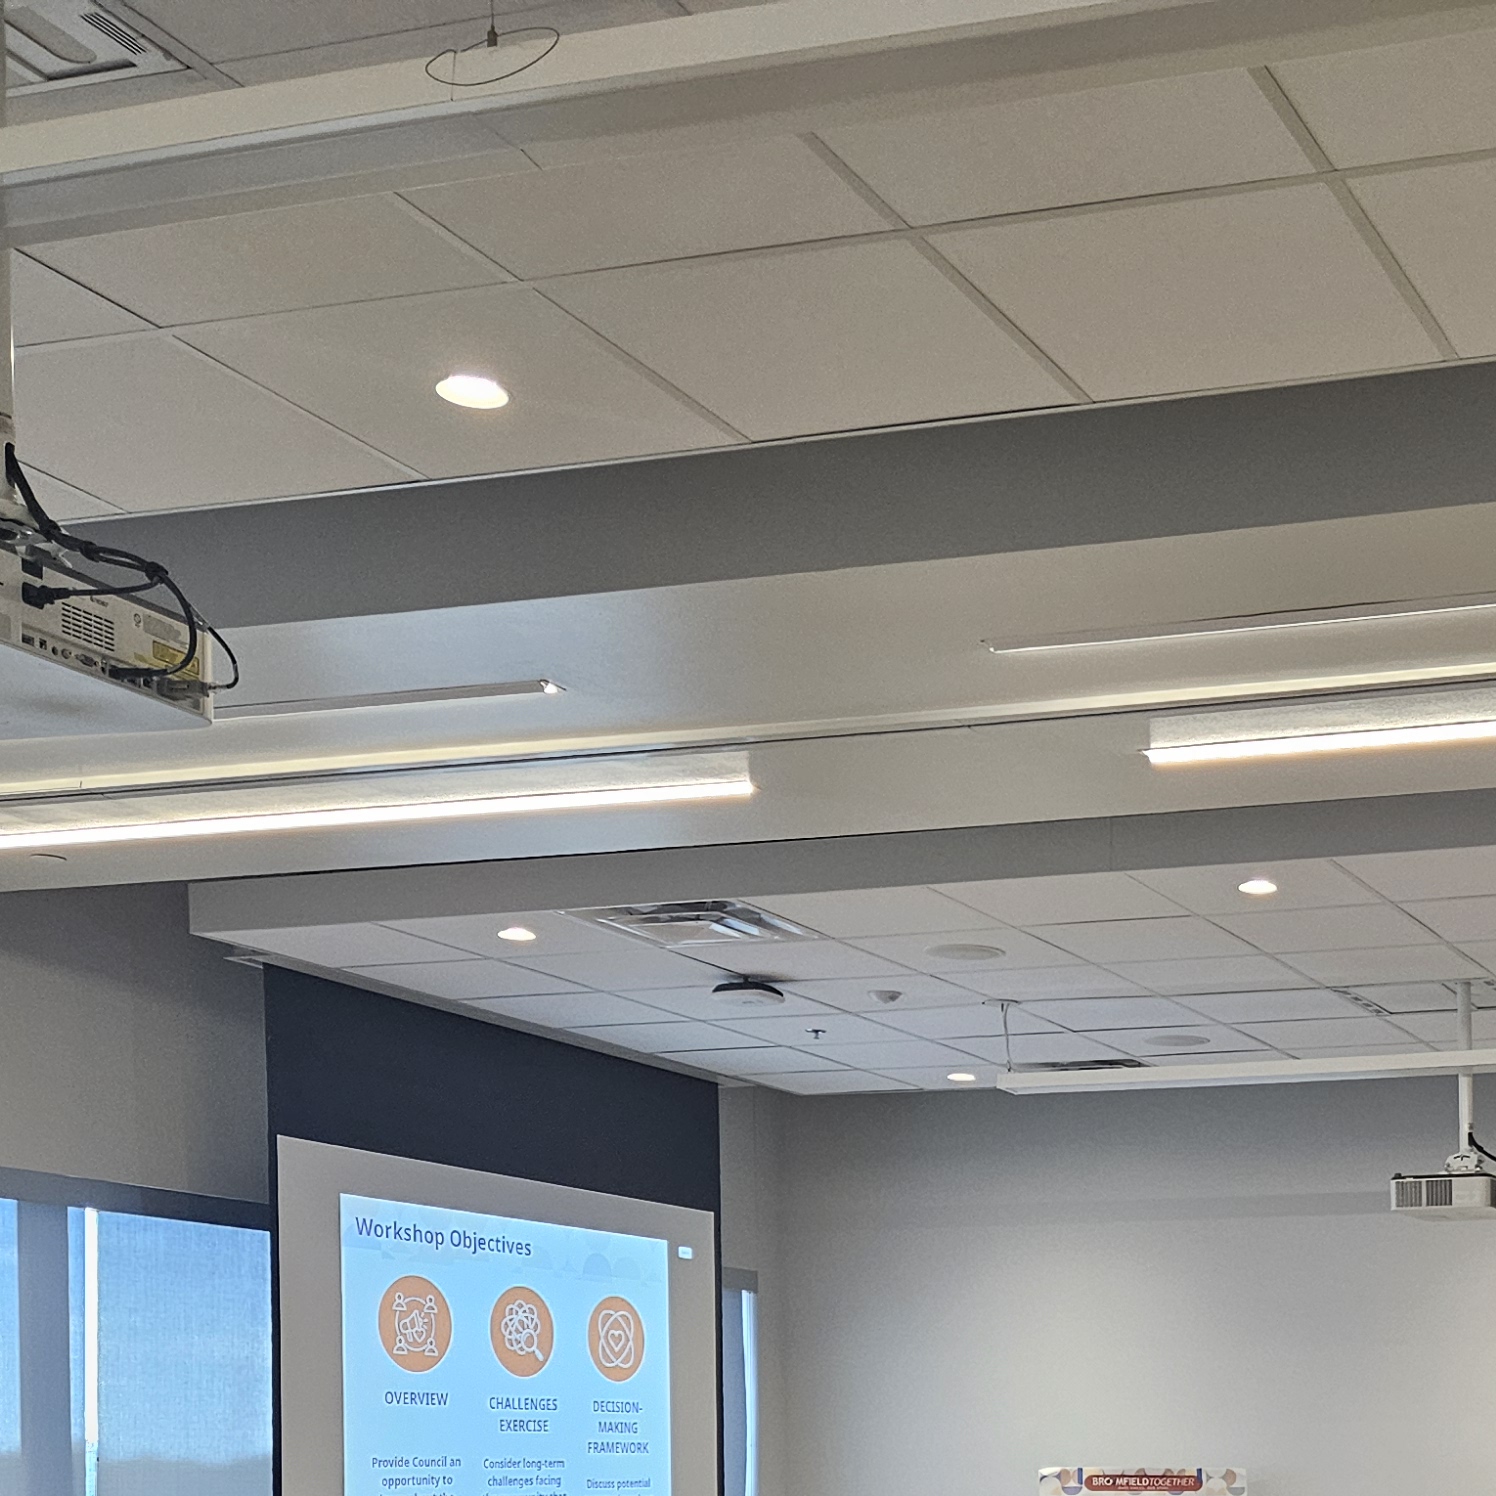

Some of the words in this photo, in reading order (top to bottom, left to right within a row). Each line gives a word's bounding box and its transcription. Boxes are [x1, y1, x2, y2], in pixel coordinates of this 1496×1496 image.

[356, 1216, 445, 1250] Workshop
[450, 1229, 532, 1256] Objectives
[385, 1391, 448, 1405] OVERVIEW
[489, 1397, 557, 1410] CHALLENGES
[593, 1401, 643, 1413] DECISION-
[500, 1420, 549, 1432] EXERCISE
[598, 1422, 638, 1433] MAKING
[588, 1442, 649, 1453] FRAMEWORK
[372, 1456, 409, 1468] Provide
[412, 1456, 447, 1467] Council
[450, 1458, 461, 1467] an
[484, 1458, 521, 1469] Consider
[523, 1458, 564, 1471] long-term
[382, 1474, 440, 1489] opportunity
[443, 1476, 453, 1484] to
[488, 1476, 533, 1488] challenges
[536, 1475, 561, 1488] facing
[587, 1479, 614, 1488] Discuss
[617, 1478, 650, 1490] potential
